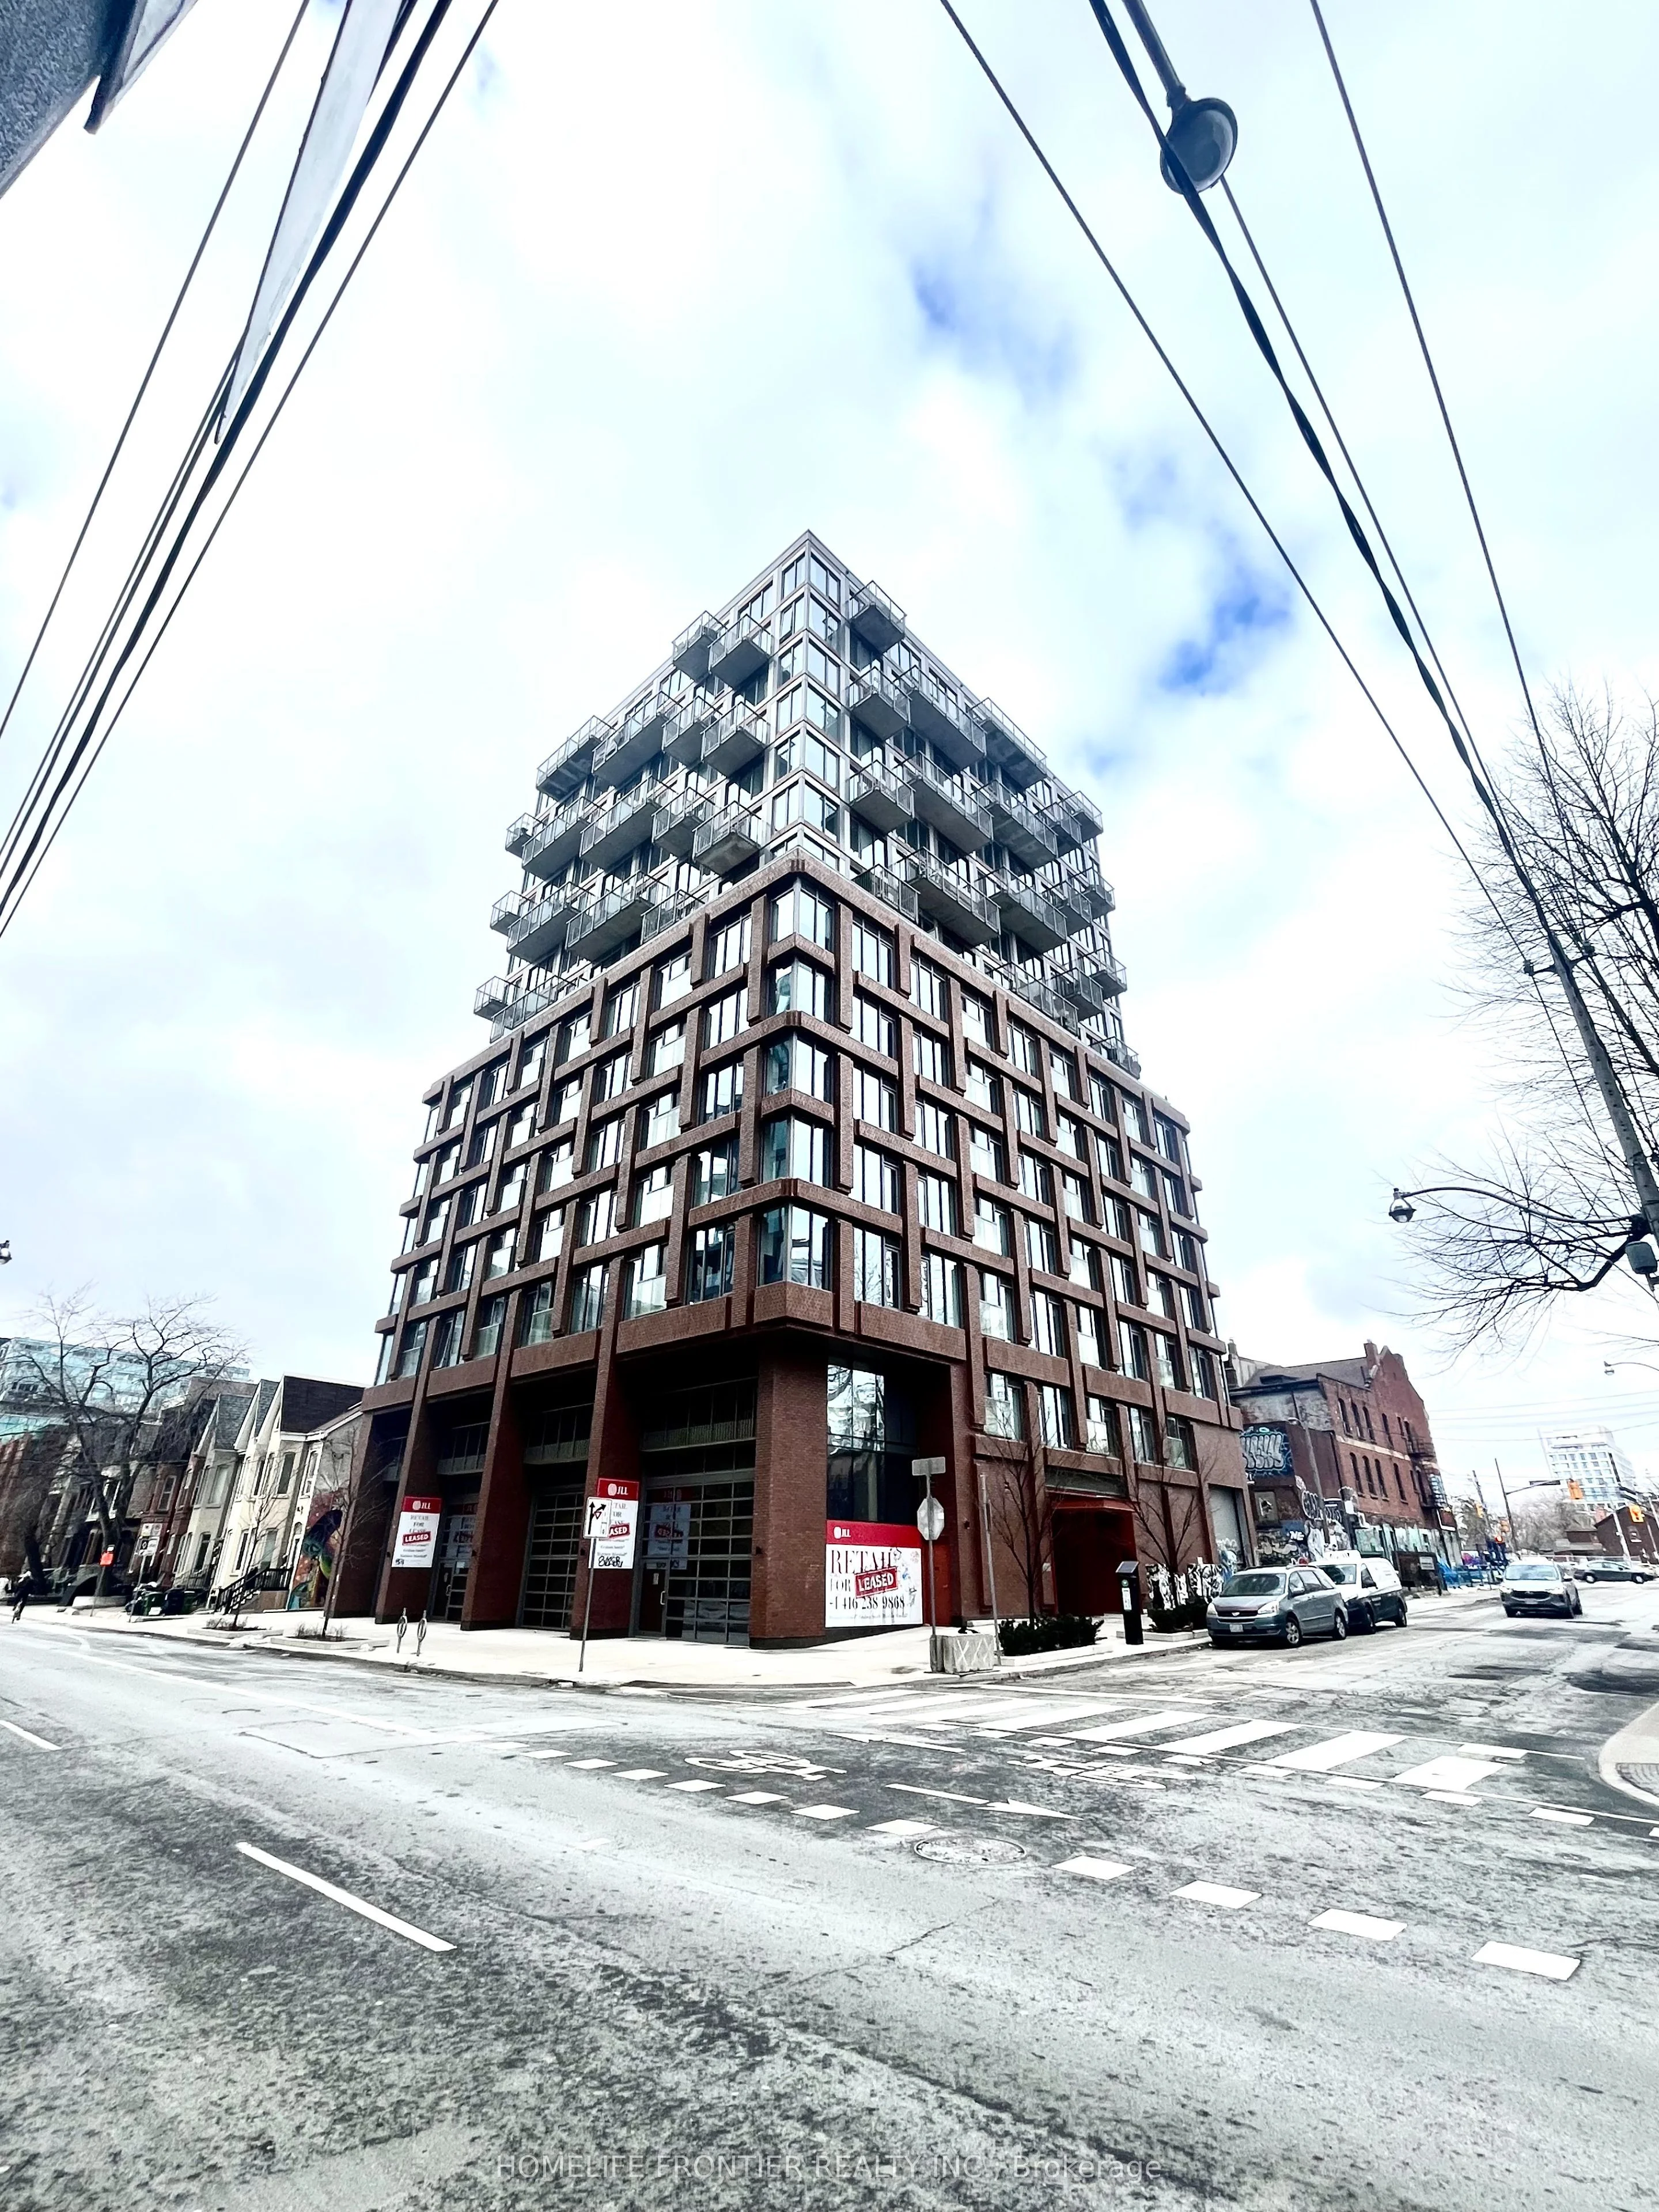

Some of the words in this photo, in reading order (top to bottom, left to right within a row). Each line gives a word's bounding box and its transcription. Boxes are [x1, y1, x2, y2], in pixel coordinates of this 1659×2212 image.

[617, 1486, 628, 1495] JLL
[610, 1527, 627, 1536] ASED
[841, 1528, 851, 1537] JLL
[405, 1533, 429, 1543] LEASED
[831, 1550, 893, 1574] RETAIL
[858, 1573, 894, 1592] LEASED
[842, 1596, 858, 1609] 416
[861, 1596, 878, 1609] 238
